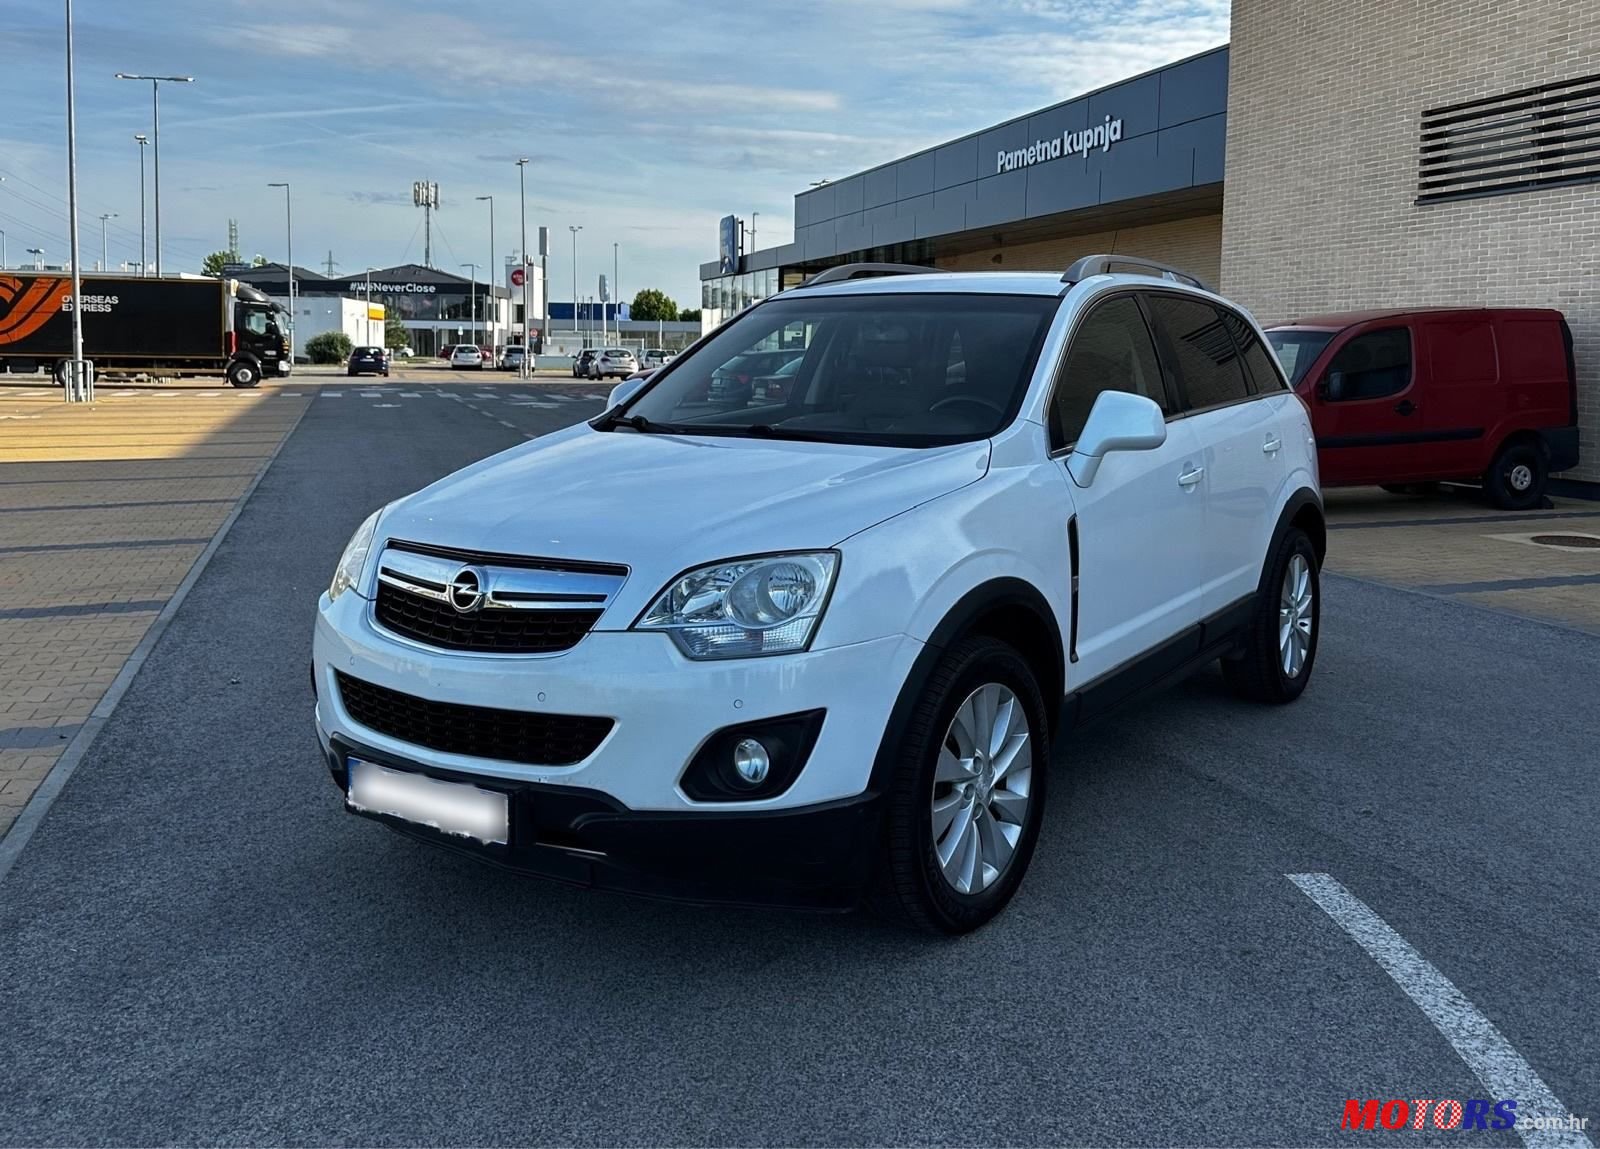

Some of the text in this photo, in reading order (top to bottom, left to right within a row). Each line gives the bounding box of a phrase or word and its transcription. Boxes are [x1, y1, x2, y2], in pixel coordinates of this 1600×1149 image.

[997, 115, 1123, 173] Pametna kupnja
[349, 282, 436, 293] #WeNeverClose
